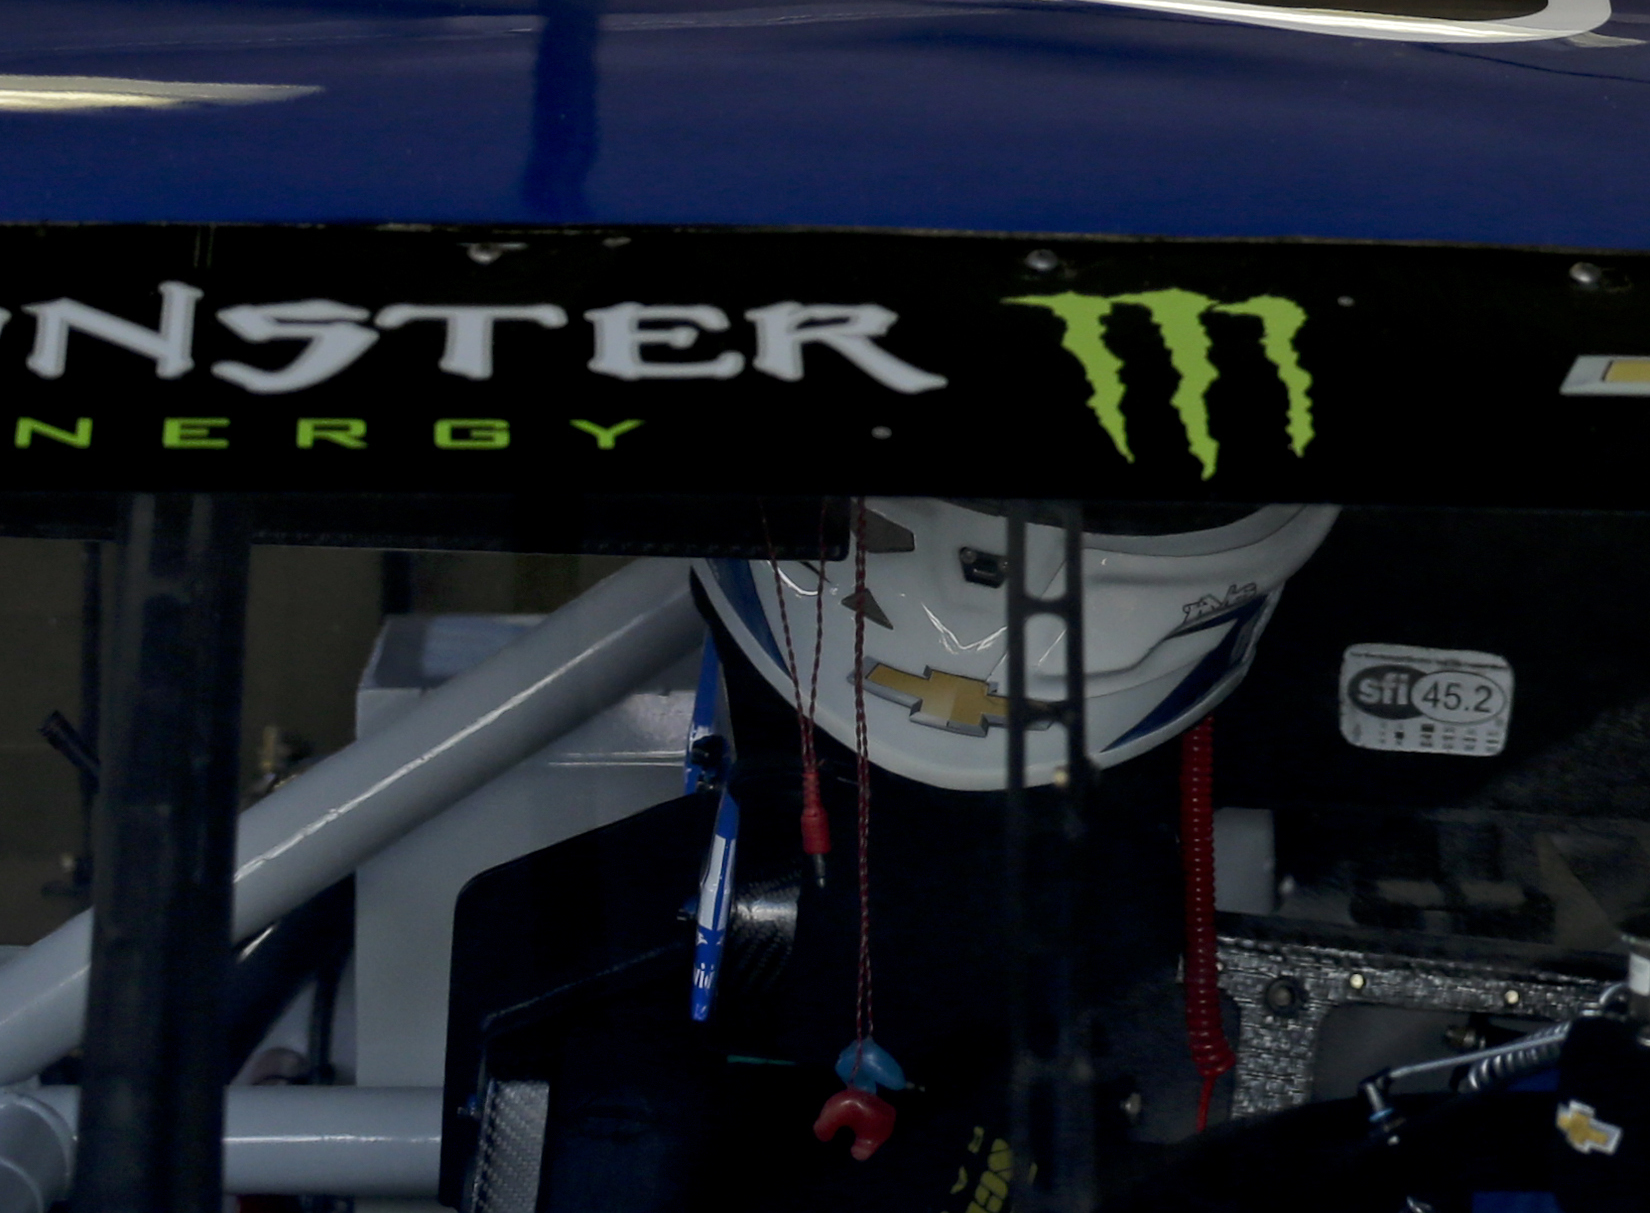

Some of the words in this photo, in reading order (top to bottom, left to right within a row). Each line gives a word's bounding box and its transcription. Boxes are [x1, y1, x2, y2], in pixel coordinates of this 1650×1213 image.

[0, 281, 949, 394] NSTER
[14, 416, 646, 450] NERGY
[1358, 671, 1411, 706] sfi
[1421, 681, 1493, 714] 45.2
